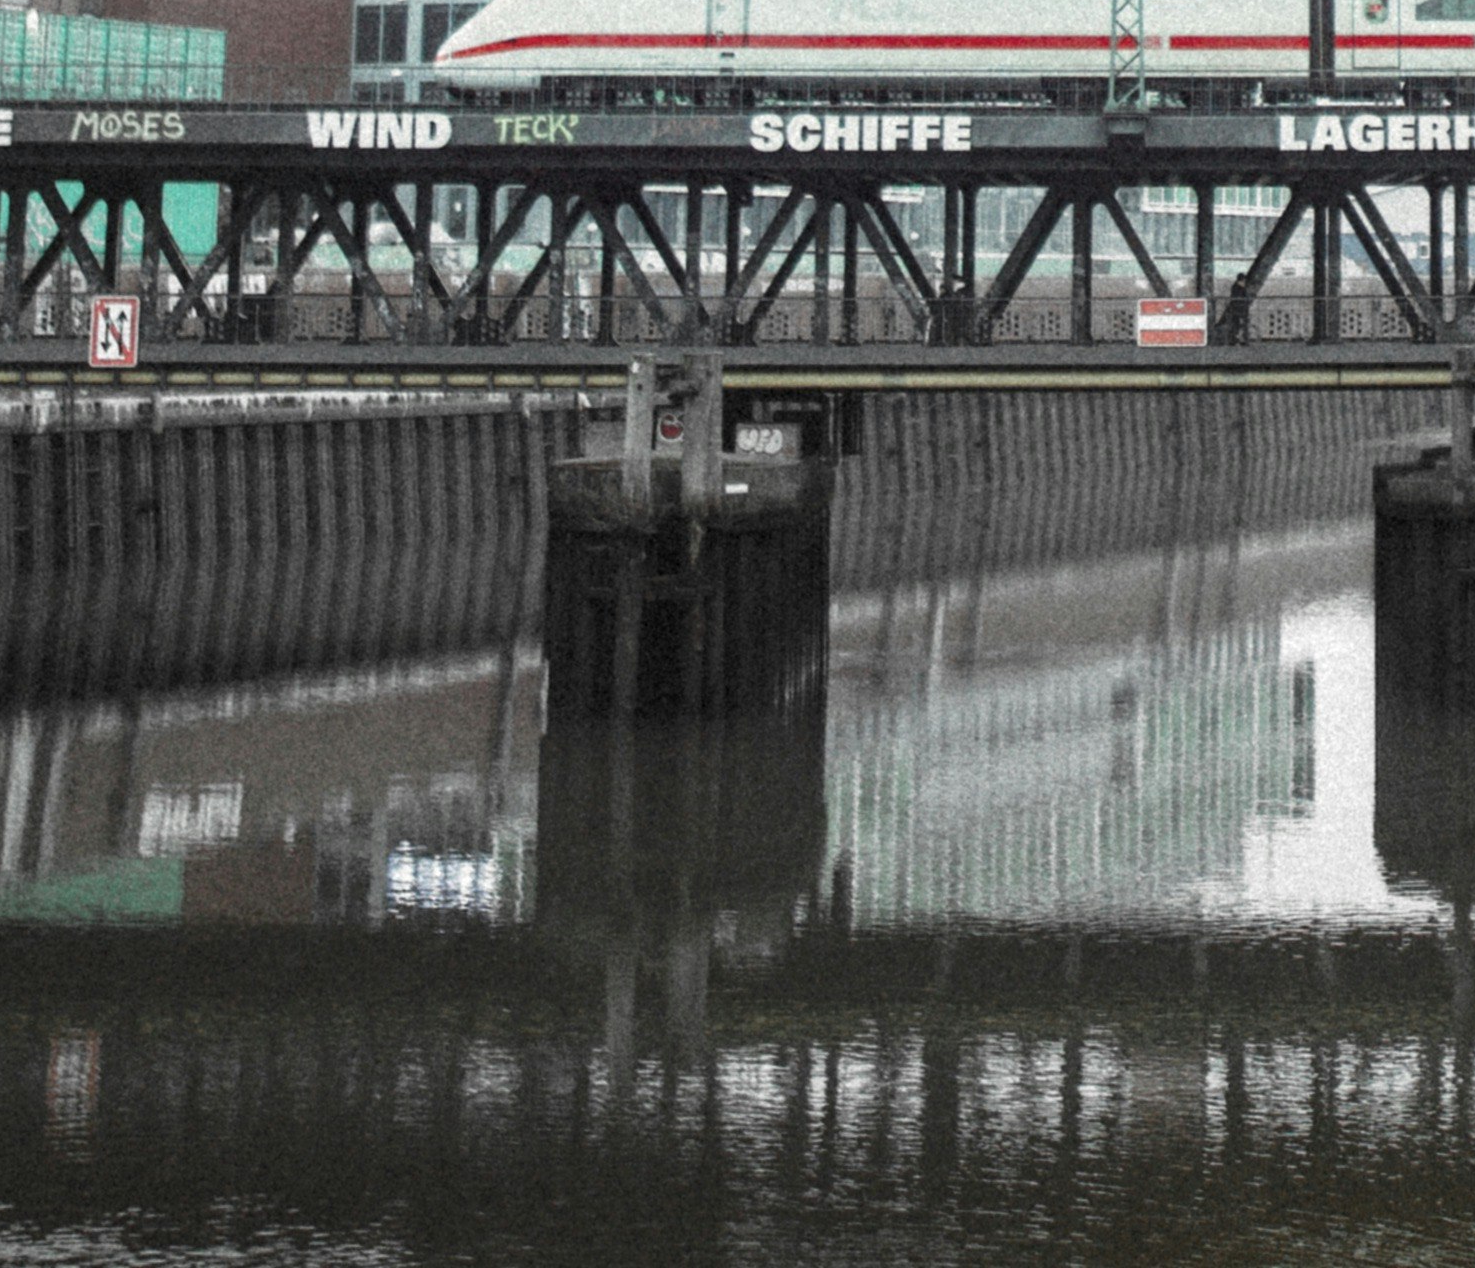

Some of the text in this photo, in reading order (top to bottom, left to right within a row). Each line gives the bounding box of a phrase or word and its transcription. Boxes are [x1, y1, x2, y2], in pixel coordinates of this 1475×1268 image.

[70, 110, 185, 141] MOSES
[307, 111, 452, 150] WIND
[749, 114, 973, 153] SCHIFFE
